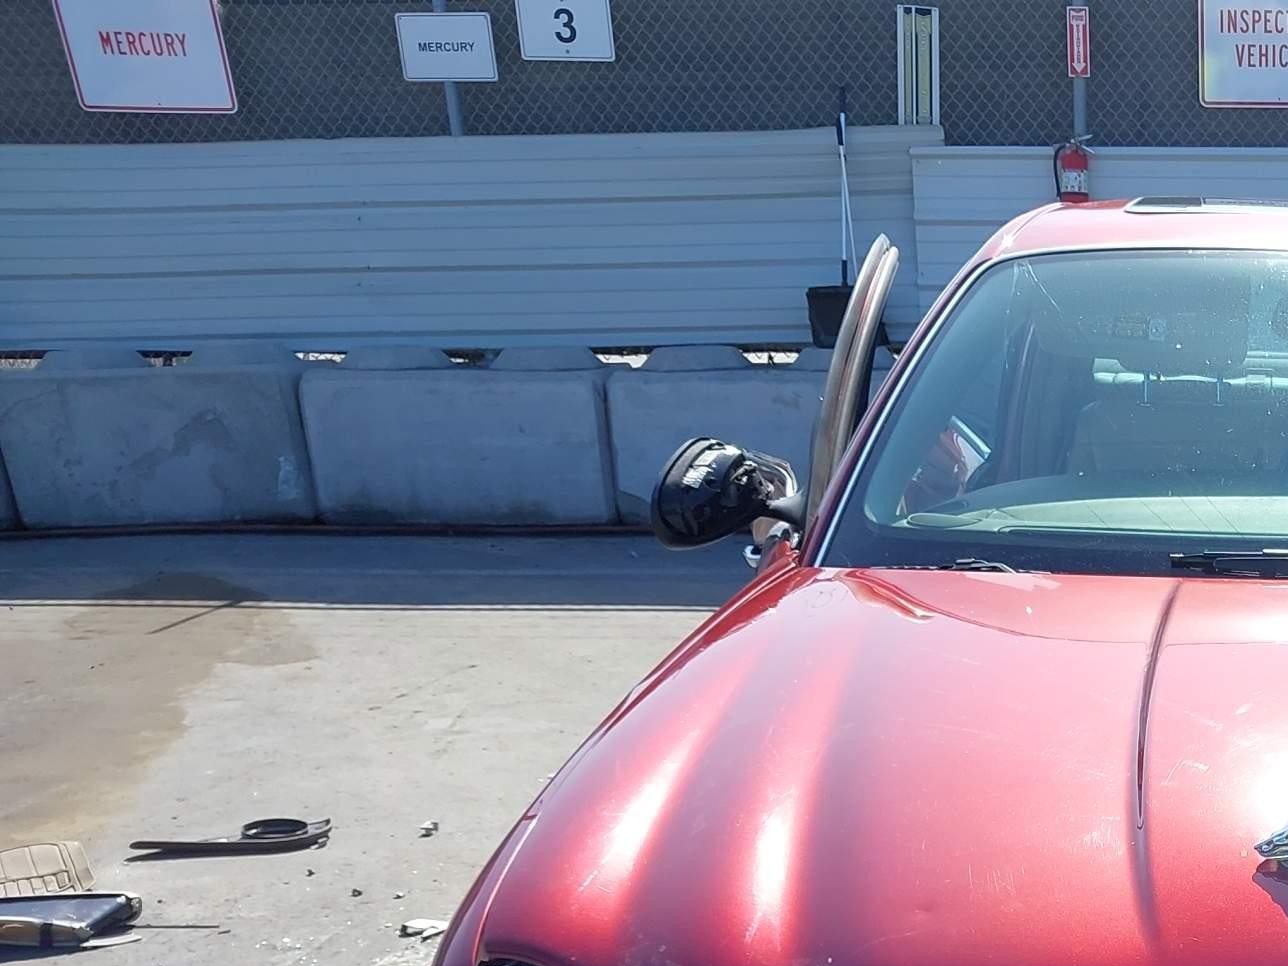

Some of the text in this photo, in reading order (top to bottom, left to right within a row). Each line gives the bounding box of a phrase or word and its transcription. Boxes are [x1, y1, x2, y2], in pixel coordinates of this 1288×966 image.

[553, 7, 577, 44] 3
[98, 31, 187, 57] MERCURY
[417, 41, 475, 53] MERCURY
